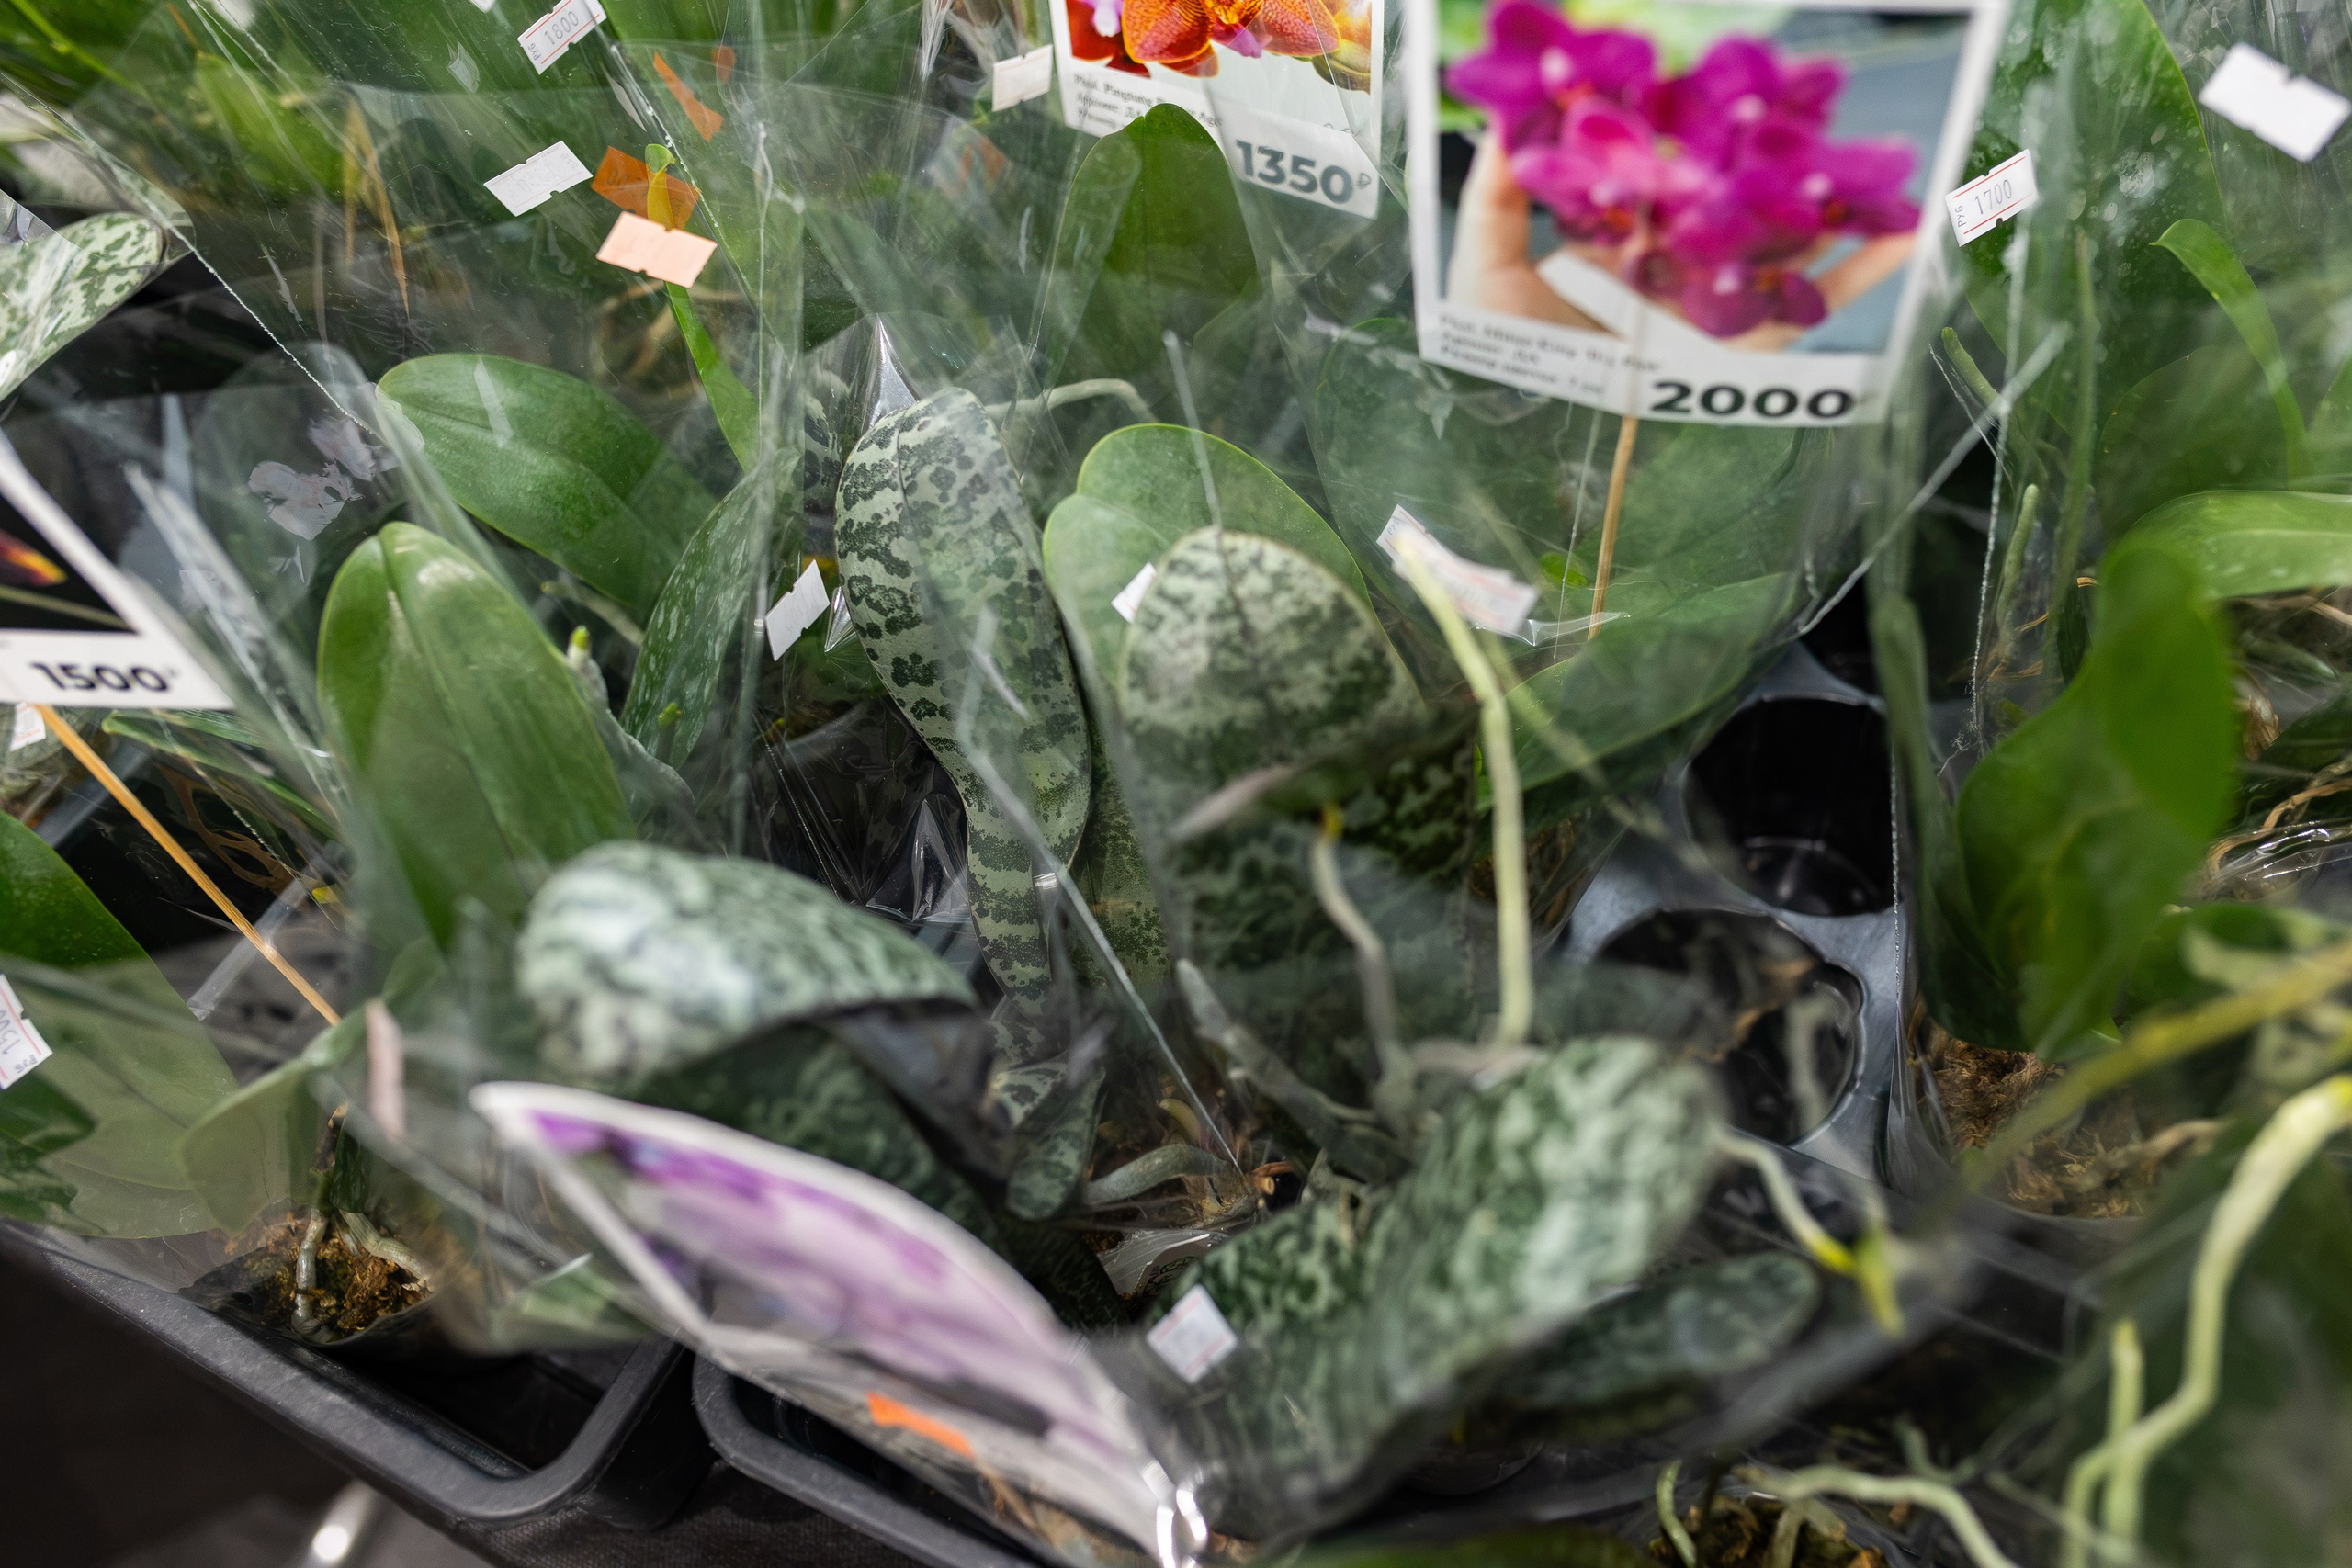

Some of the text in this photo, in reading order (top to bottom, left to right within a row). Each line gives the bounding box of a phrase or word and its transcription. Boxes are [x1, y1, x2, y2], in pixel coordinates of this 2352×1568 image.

[544, 11, 579, 45] 1800
[1974, 179, 2012, 215] 1700
[1650, 379, 1857, 419] 2000
